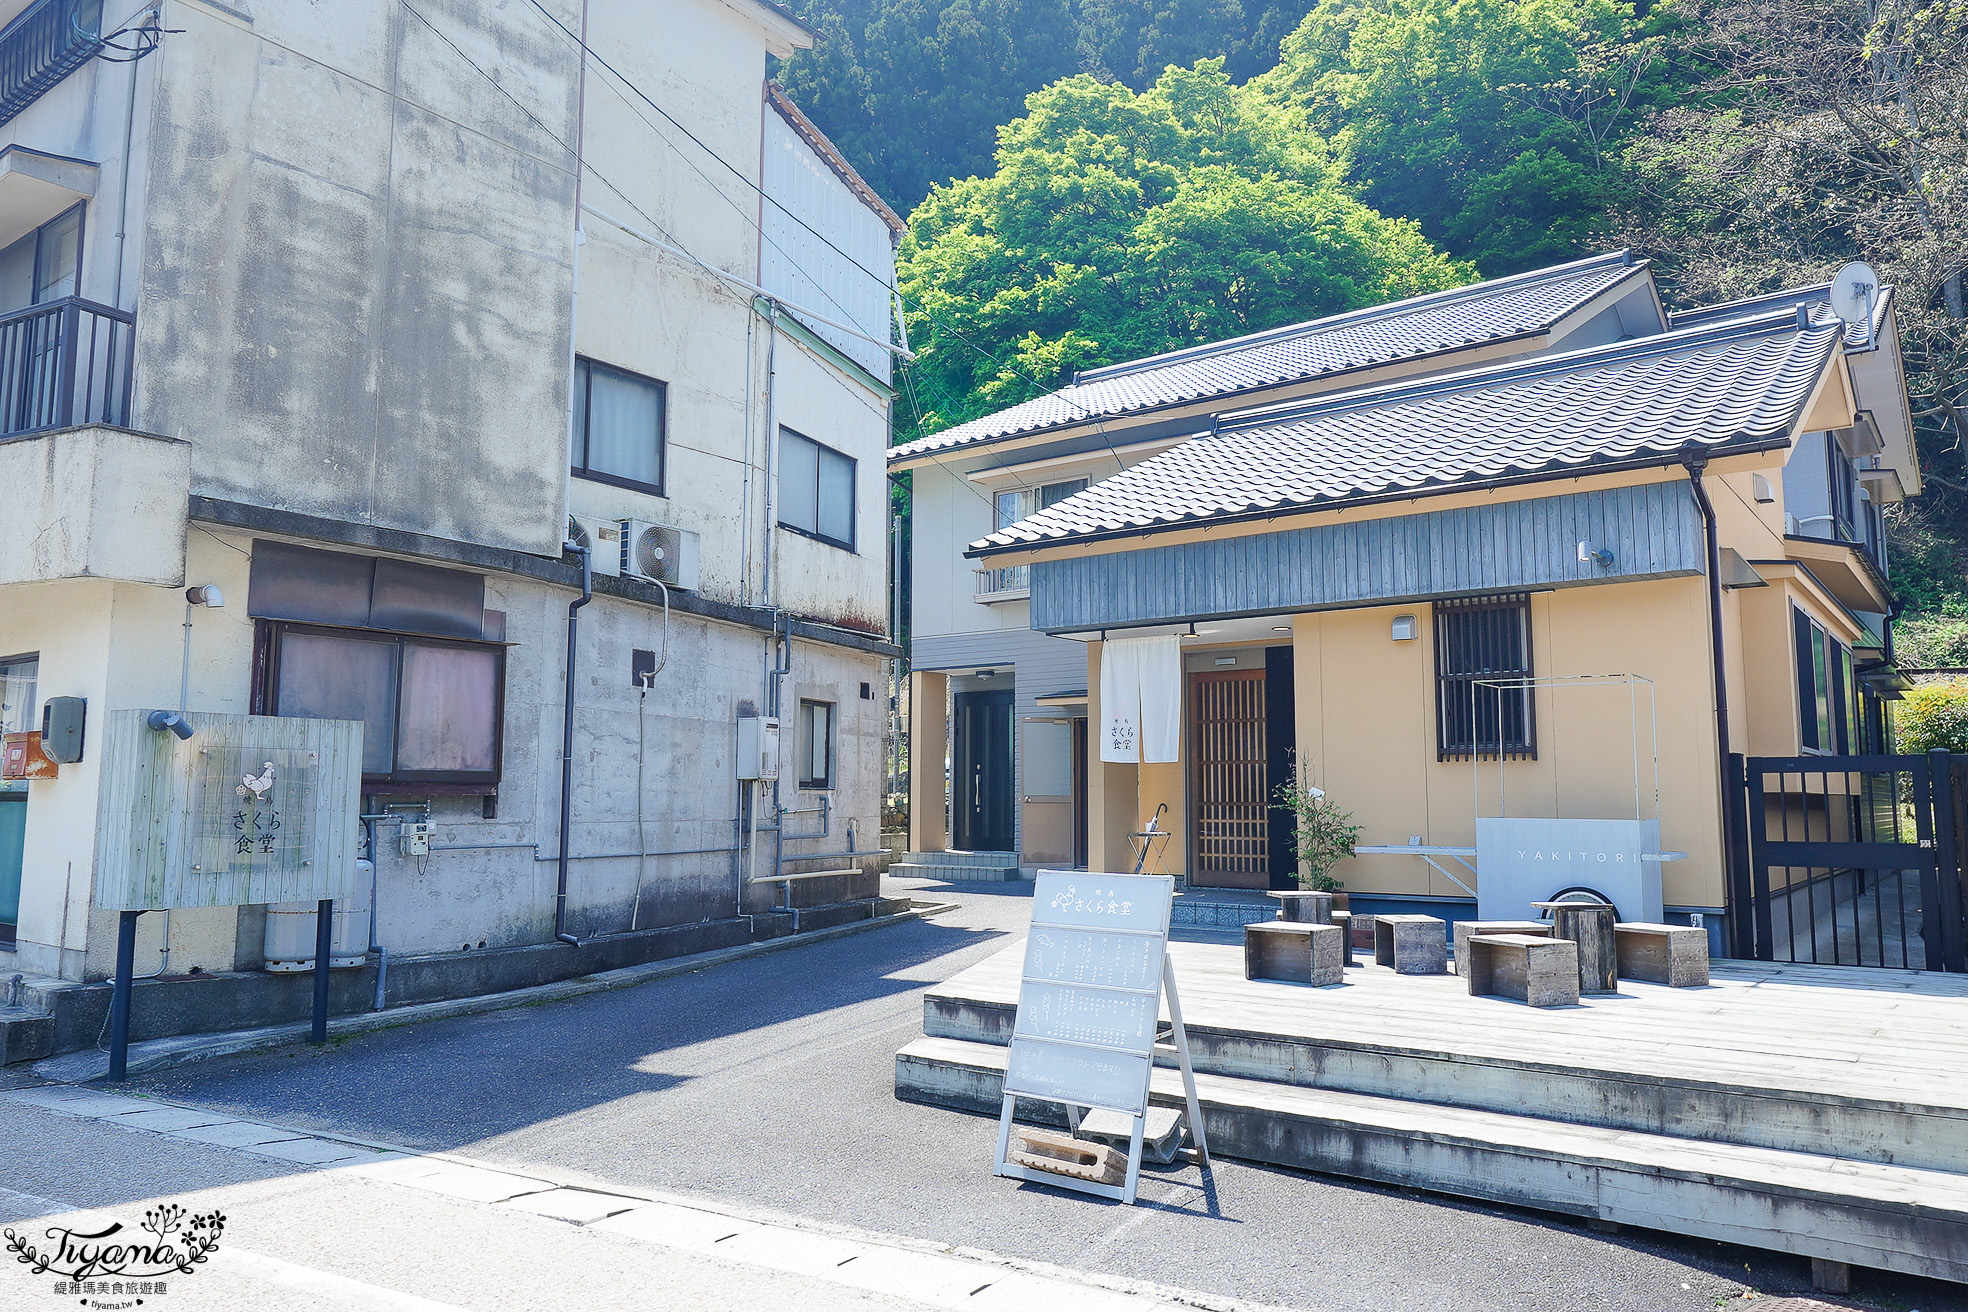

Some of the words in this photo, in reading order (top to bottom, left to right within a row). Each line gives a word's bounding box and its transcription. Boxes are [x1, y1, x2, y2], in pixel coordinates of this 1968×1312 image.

[1111, 726, 1134, 738] さくら
[232, 810, 281, 831] さくら
[234, 834, 276, 855] 食堂
[1518, 850, 1637, 863] YAKITORI
[1074, 898, 1135, 916] さくら食堂
